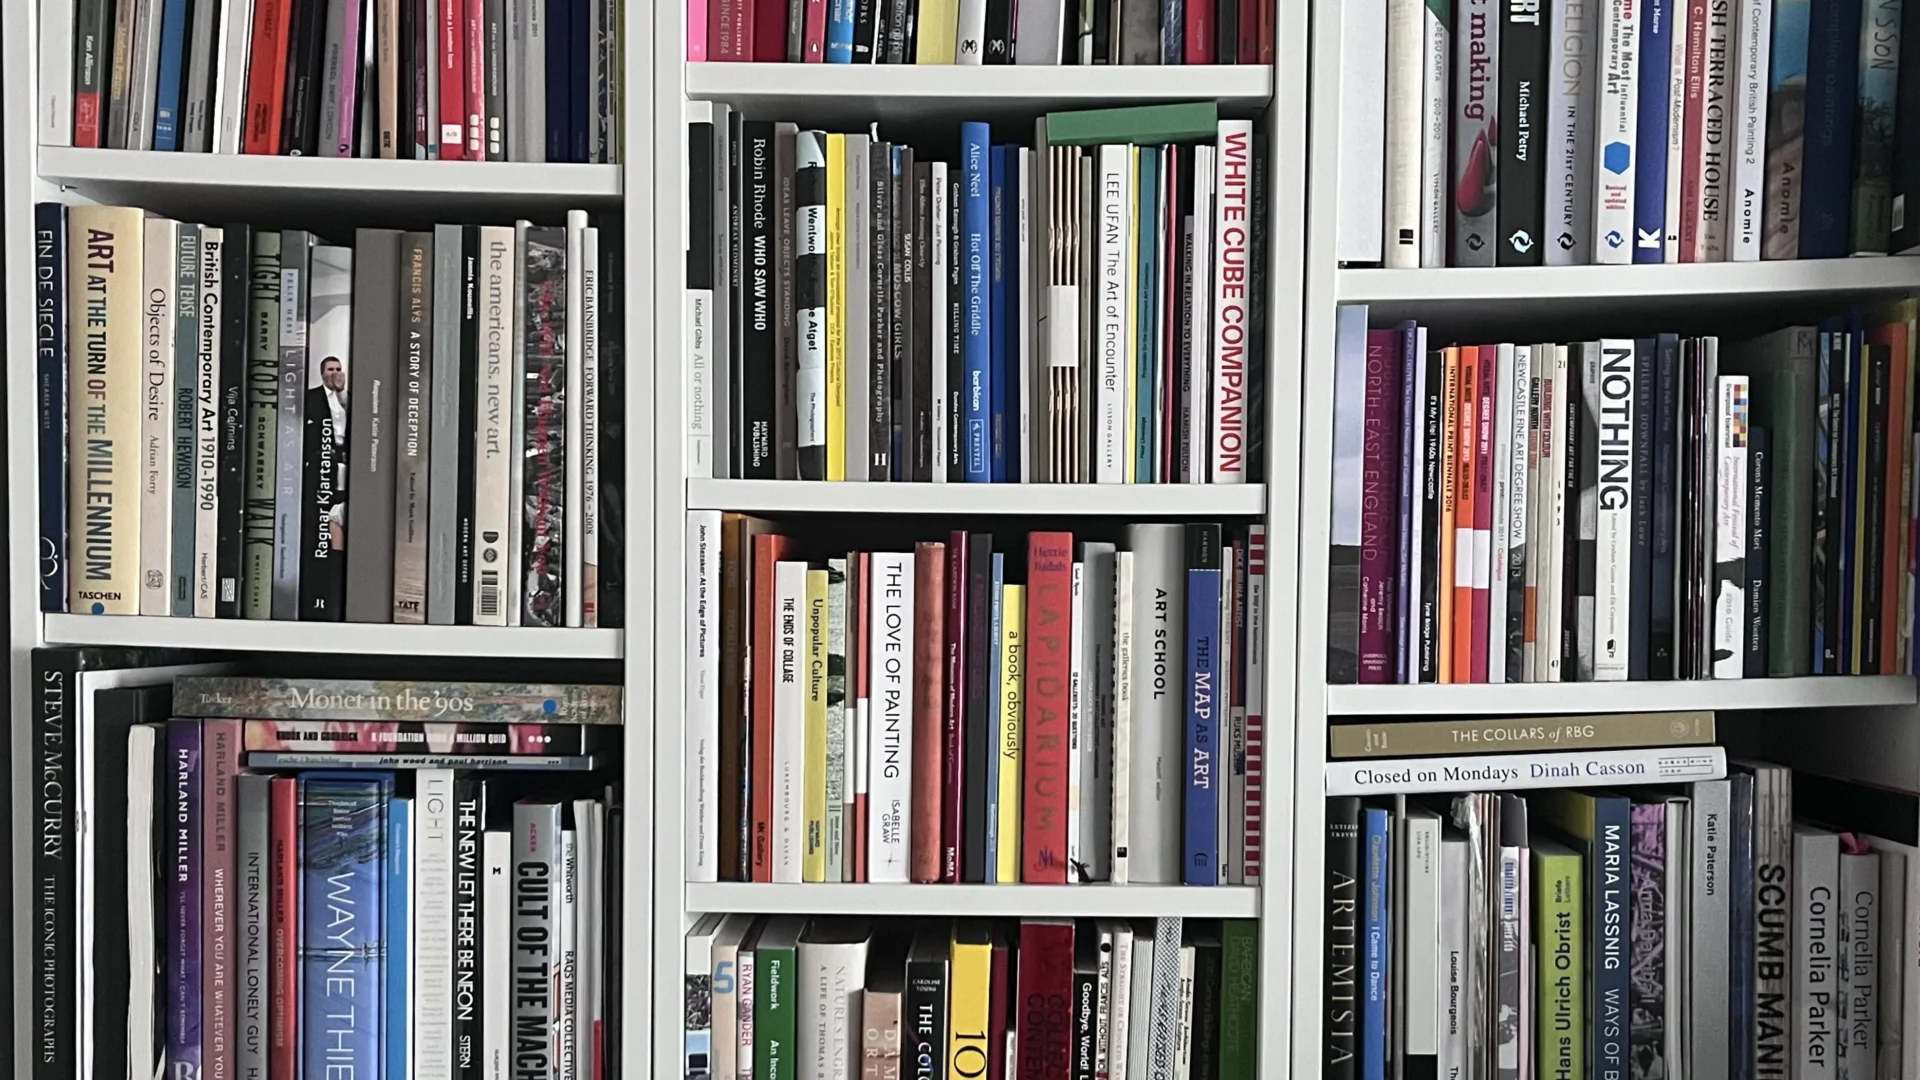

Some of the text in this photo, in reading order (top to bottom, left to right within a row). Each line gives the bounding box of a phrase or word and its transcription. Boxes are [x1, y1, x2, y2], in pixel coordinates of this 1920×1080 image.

[84, 36, 94, 85] Ken Allinson
[1464, 13, 1490, 121] making
[1516, 81, 1530, 161] Michael Petry
[1703, 35, 1726, 221] TERRACED HOUSE
[970, 143, 981, 197] Alice Neel
[180, 235, 194, 317] FUTURE TENSE
[203, 241, 218, 288] British
[412, 249, 422, 293] FRANCIS
[753, 139, 766, 330] Robin Rhode WHO SAW WHO
[38, 231, 53, 357] FIN DE SIECLE
[970, 233, 982, 335] Hot Off The Griddle
[1105, 173, 1119, 392] LEE UFAN The Art of Encounter
[1219, 132, 1246, 472] WHITE CUBE COMPANION
[148, 288, 165, 421] Objects of Desire
[199, 293, 217, 402] Contemporary
[408, 381, 420, 393] OF
[409, 343, 420, 377] STORY
[486, 241, 506, 459] the americans. new art.
[693, 372, 703, 383] or
[694, 354, 704, 368] All
[86, 228, 114, 580] ART AT THE TURN OF THE MILLENNIUM
[201, 408, 215, 432] Art
[226, 387, 238, 450] Vija Celmins
[407, 398, 419, 456] DECEPTION
[691, 386, 704, 429] nothing
[972, 371, 981, 410] barbican
[1600, 348, 1631, 510] NOTHING
[147, 435, 159, 495] Adrian Forty
[177, 388, 193, 488] ROBERT HEWISON
[973, 433, 981, 467] PRESTEL
[1363, 345, 1381, 560] NORTH-EAST ENGLAND
[1512, 354, 1526, 577] NEWCASTLE FINE ART DEGREE SHOW 2013
[1754, 452, 1763, 482] Corona
[315, 418, 333, 558] Ragnar Kjartansson
[1753, 528, 1762, 550] Mori
[78, 591, 121, 600] TASCHEN
[1752, 580, 1762, 613] Damien
[783, 598, 794, 682] THE ENDS OF COLLAGE
[810, 598, 823, 701] Unpopular Culture
[884, 563, 902, 778] THE LOVE OF PAINTING
[1154, 589, 1166, 699] ART SCHOOL
[291, 687, 365, 710] Monet
[370, 691, 389, 711] in
[394, 692, 429, 711] the
[1005, 631, 1021, 759] a book, obviously
[1194, 637, 1210, 788] THE MAP AS ART
[1452, 726, 1594, 742] THE COLLARS of RBG
[43, 671, 63, 860] STEVE McCURRY
[1354, 765, 1518, 785] Closed on Mondays
[1530, 761, 1645, 779] Dinah Casson
[178, 749, 189, 882] HARLAND MILLER
[882, 814, 892, 843] GRAW
[891, 800, 900, 843] ISABELLE
[457, 800, 476, 1020] THE NEW LET THERE BE NEON
[1605, 825, 1620, 969] MARIA LASSNIG
[44, 875, 55, 1063] THE ICONIC PHOTOGRAPHS
[770, 960, 780, 1010] Fieldwork
[1331, 871, 1355, 1065] ARTEMISIA
[1448, 951, 1459, 1034] Louise Bourgeois
[1809, 887, 1830, 1067] Cornelia Parker
[459, 1035, 471, 1067] STERN
[1081, 983, 1092, 1070] Goodbye, World!
